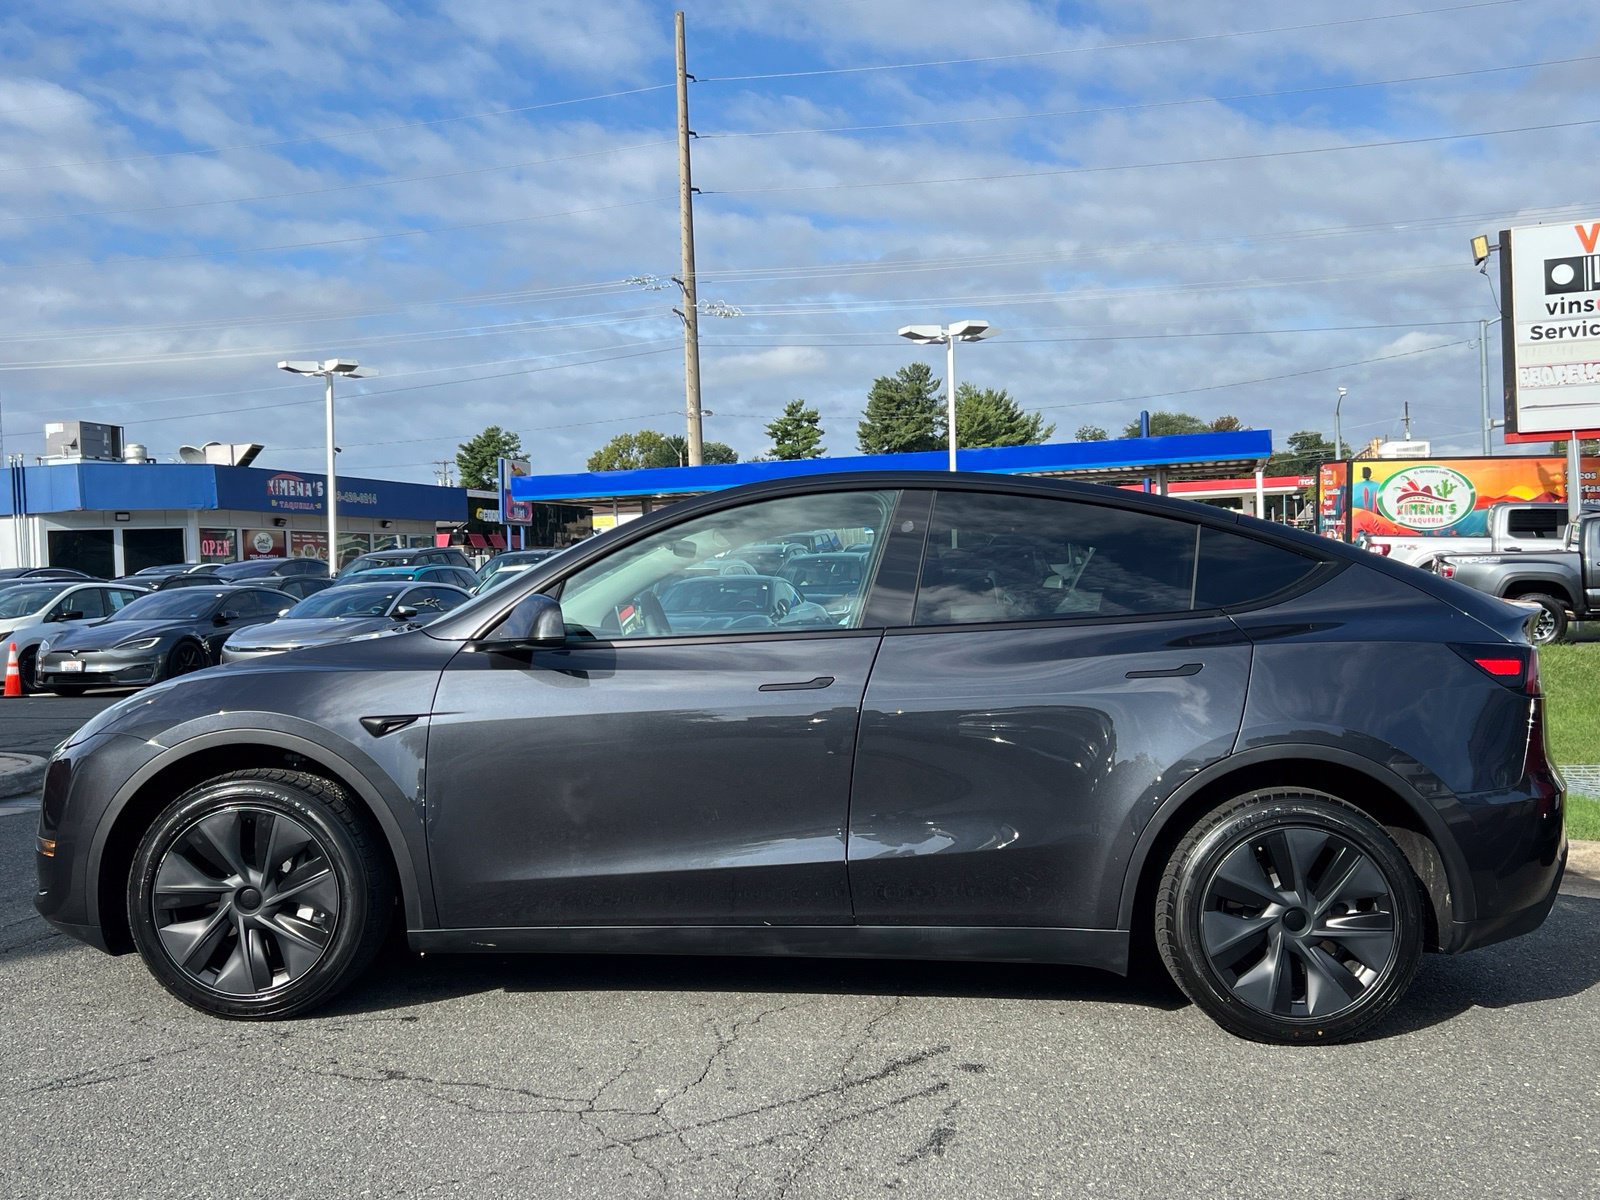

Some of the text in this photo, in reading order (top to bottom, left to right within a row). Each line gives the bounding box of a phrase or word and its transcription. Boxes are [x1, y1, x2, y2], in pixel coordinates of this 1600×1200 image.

[267, 479, 324, 497] XIMENA'S
[1396, 503, 1457, 516] XIMENA'S
[202, 540, 230, 556] OPEN
